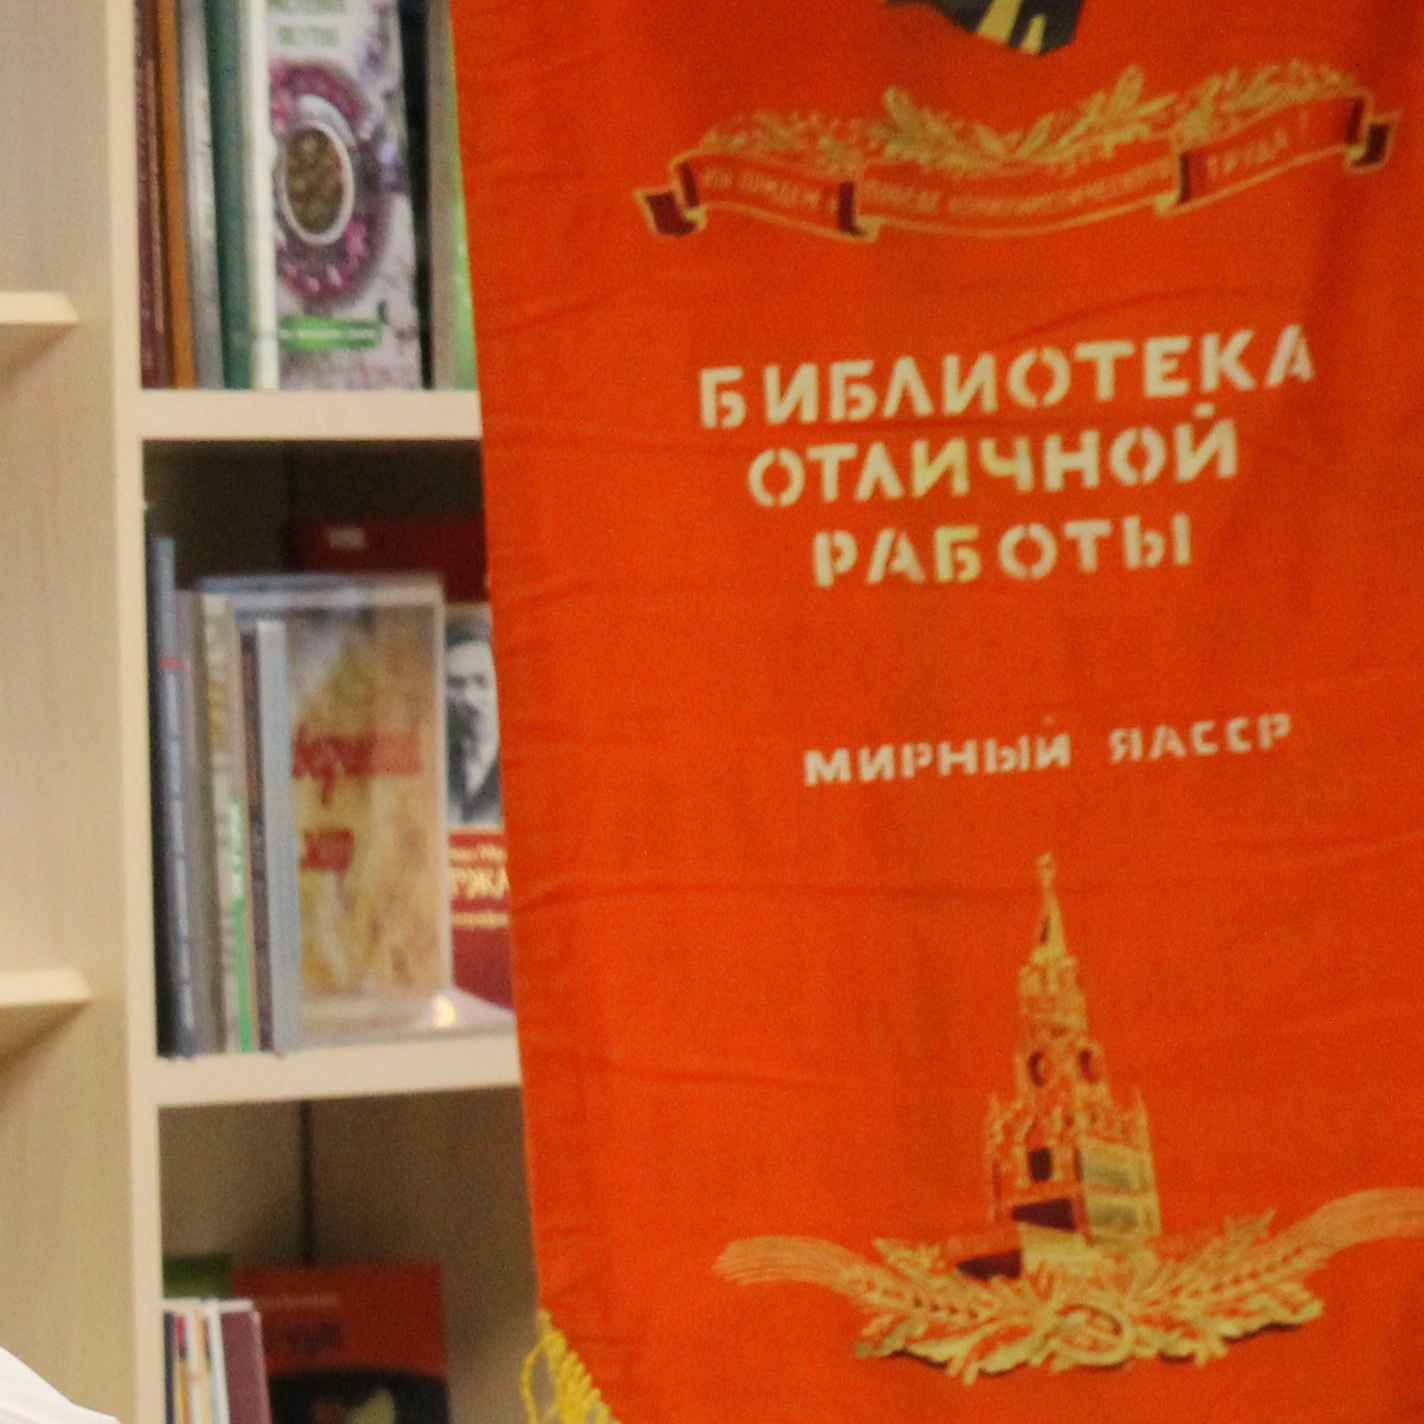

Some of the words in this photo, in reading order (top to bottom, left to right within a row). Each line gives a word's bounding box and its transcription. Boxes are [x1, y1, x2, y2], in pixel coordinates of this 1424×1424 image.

[698, 323, 1316, 430] БИБЛИОТЕКА
[747, 405, 1240, 507] ОТЛИЧНОЙ
[812, 513, 1193, 587] РАБОТЫ
[803, 716, 1072, 787] МИРНЫЙ
[1107, 711, 1294, 765] ЯАССР
